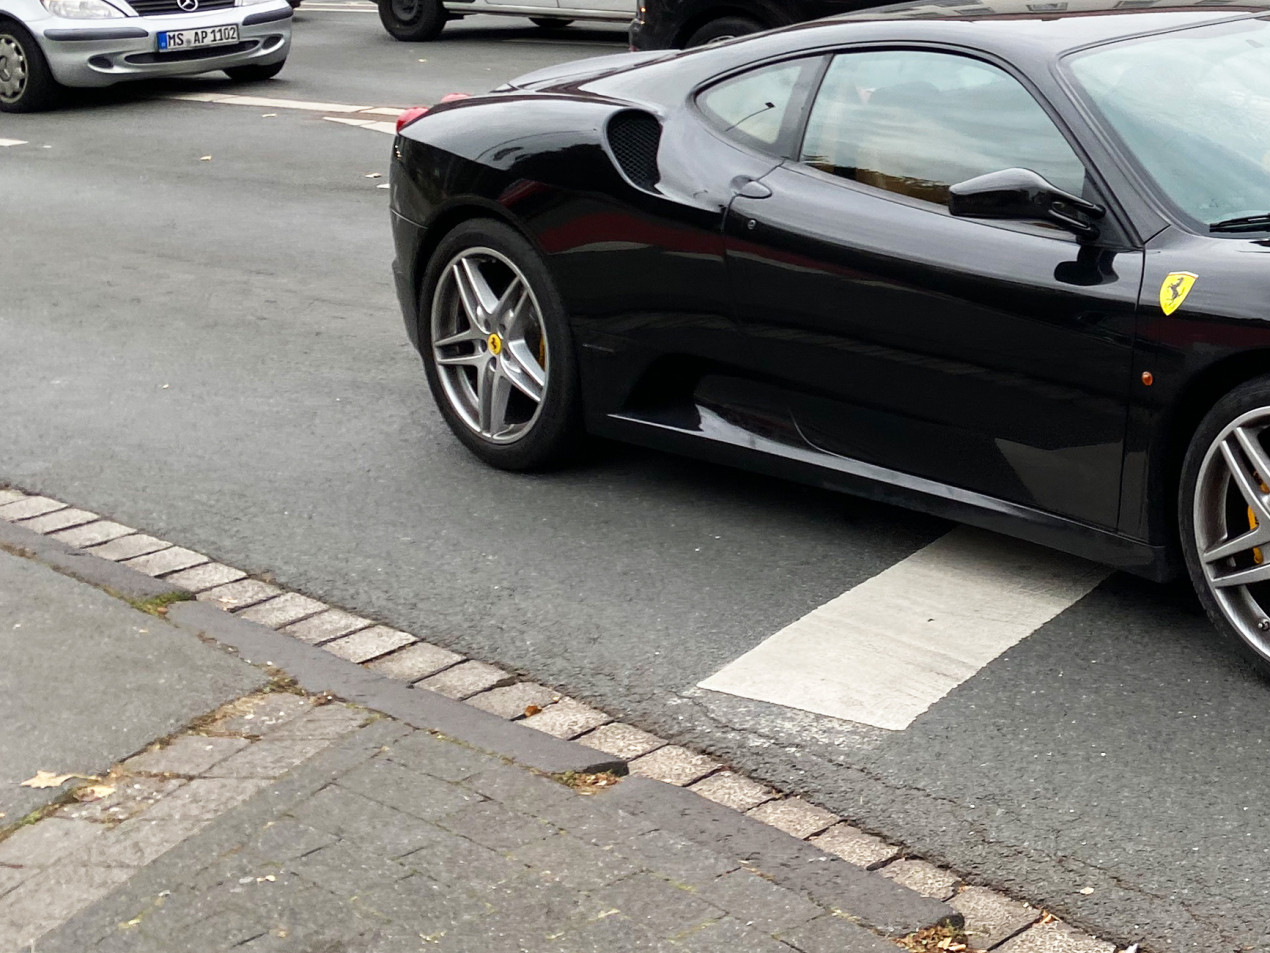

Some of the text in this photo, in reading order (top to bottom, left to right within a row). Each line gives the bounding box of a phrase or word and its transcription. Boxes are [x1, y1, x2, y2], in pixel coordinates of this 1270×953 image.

[168, 27, 237, 47] MS AP 1102
